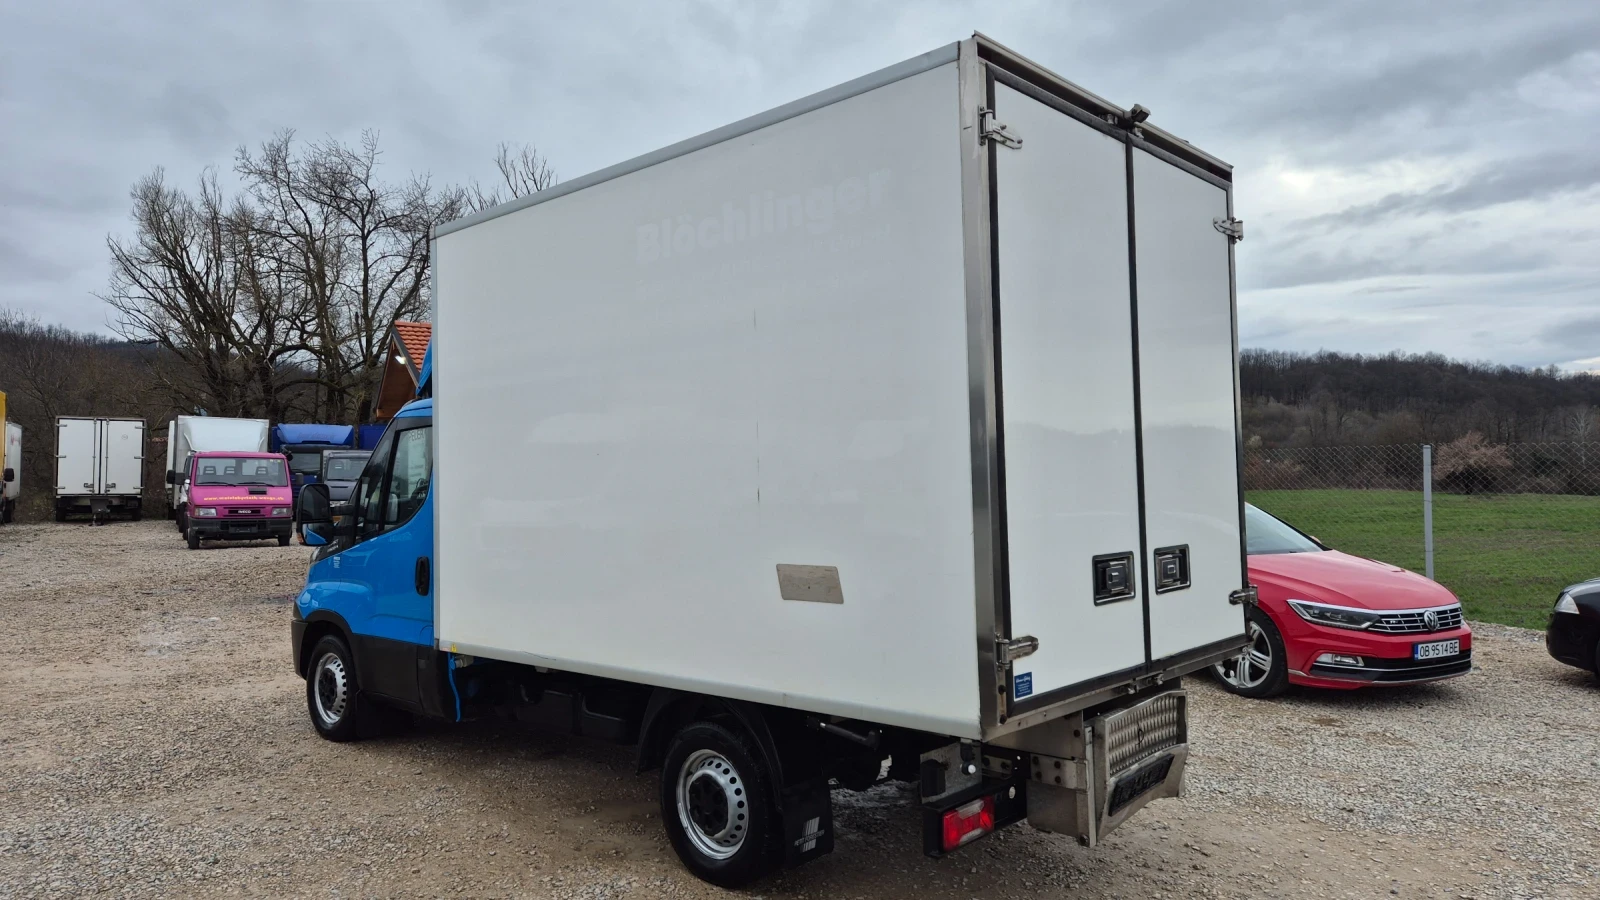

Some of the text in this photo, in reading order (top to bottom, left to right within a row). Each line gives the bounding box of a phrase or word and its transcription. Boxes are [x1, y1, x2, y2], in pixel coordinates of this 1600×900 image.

[636, 168, 891, 265] Blöchlinger
[1420, 641, 1458, 658] OB 9514 BE
